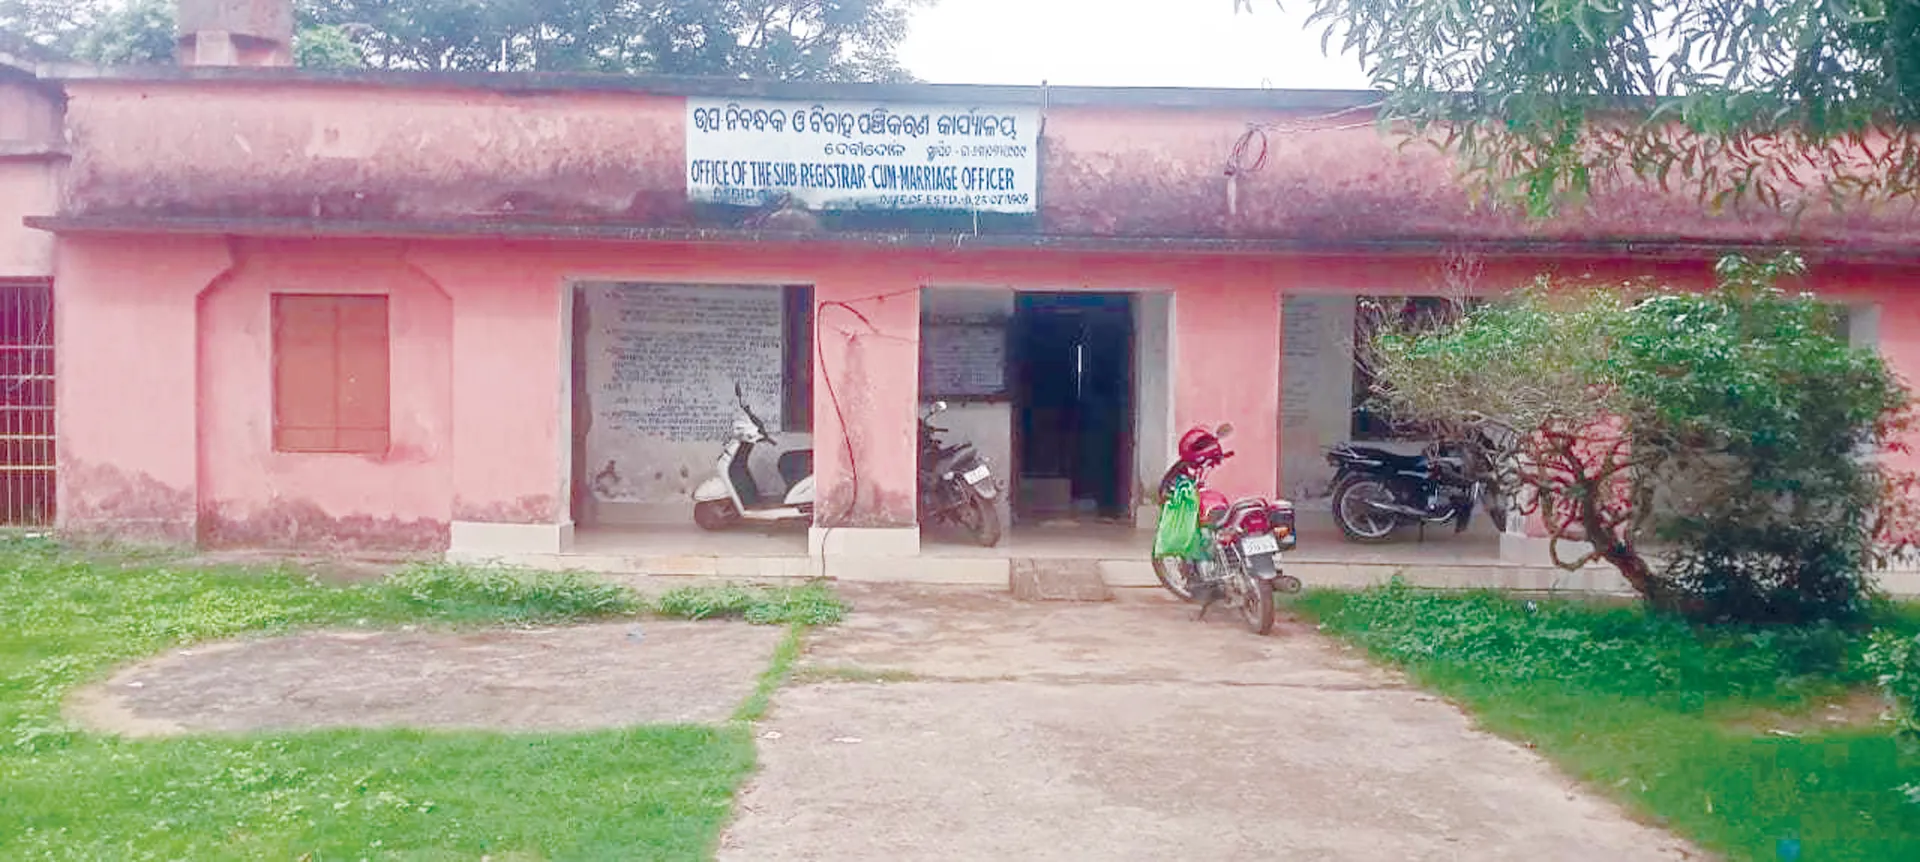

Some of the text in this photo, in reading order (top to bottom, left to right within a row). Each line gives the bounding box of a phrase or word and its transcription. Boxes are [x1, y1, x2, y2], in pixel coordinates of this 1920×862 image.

[792, 110, 806, 133] ଓ
[691, 160, 730, 187] OFFICE
[732, 161, 748, 187] OF
[750, 161, 772, 187] THE
[962, 166, 1015, 191] OFFICER
